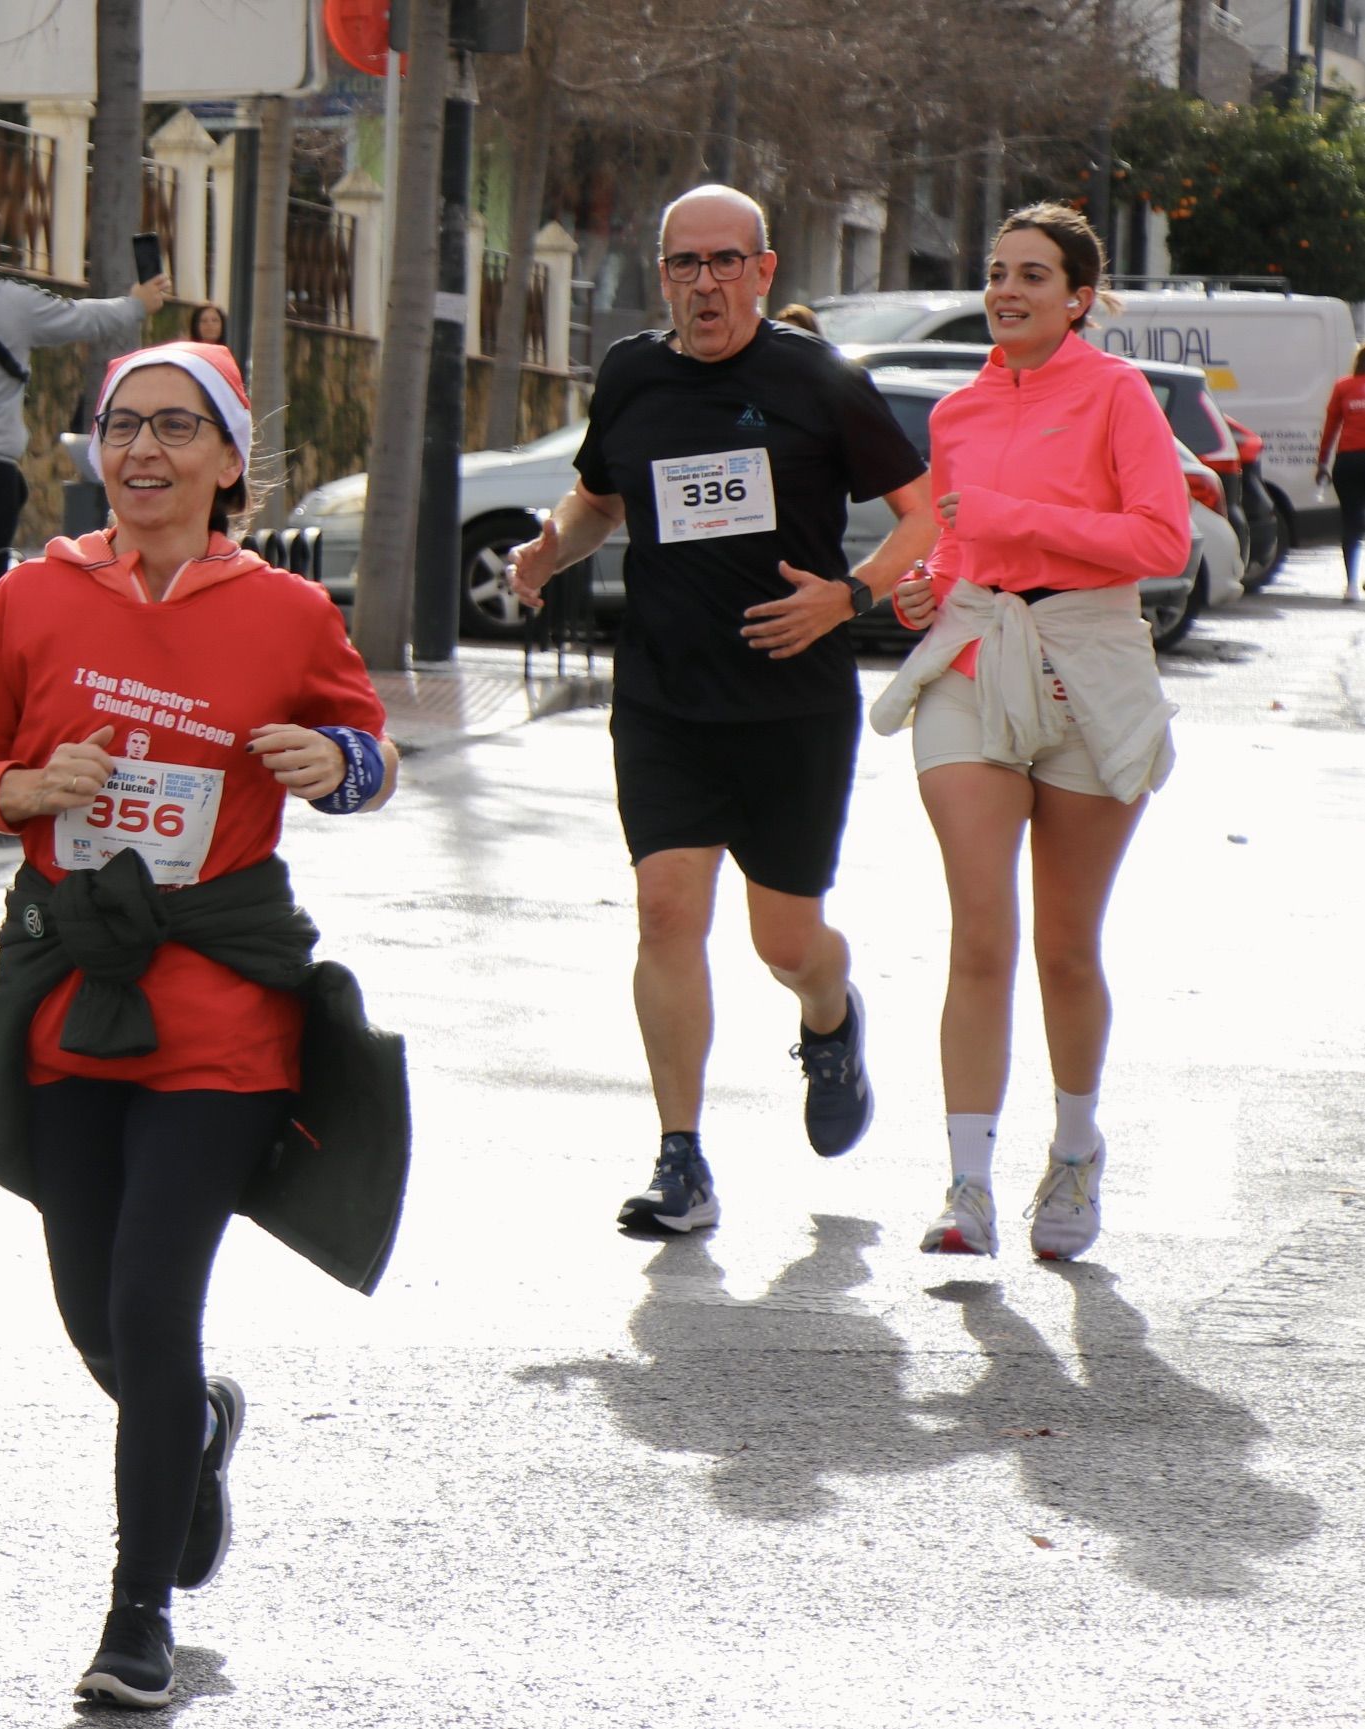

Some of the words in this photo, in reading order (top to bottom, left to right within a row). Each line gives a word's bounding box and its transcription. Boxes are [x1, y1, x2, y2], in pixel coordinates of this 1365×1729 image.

[682, 478, 747, 507] 336
[73, 667, 86, 685] I
[86, 670, 118, 693] San
[119, 678, 195, 713] Silvestre
[93, 692, 153, 722] Ciudad
[153, 709, 176, 729] de
[176, 714, 236, 747] Lucena
[107, 780, 119, 790] de
[121, 782, 155, 795] Lucena
[86, 794, 185, 838] 356
